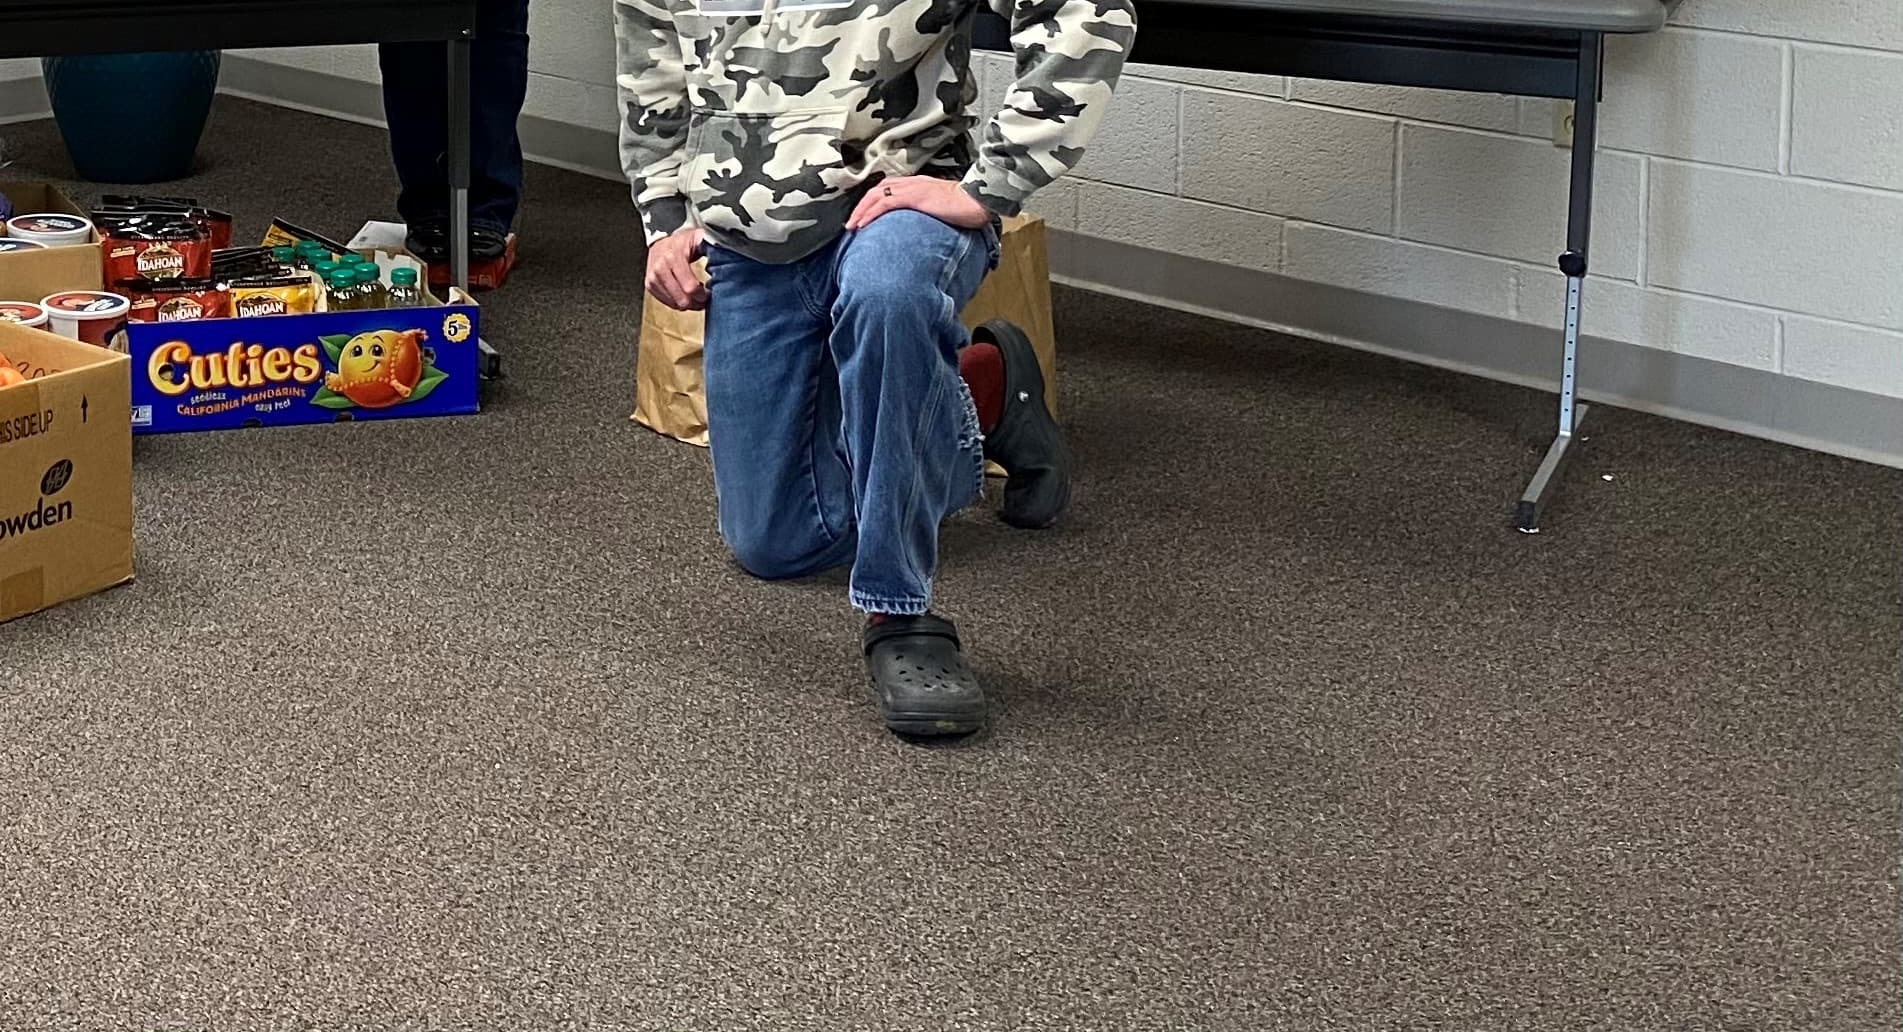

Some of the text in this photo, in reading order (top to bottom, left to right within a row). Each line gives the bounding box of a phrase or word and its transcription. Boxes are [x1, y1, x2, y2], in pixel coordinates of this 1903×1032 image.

[138, 256, 183, 272] IDAHOAN
[159, 307, 202, 322] IDAHOAN
[240, 302, 284, 318] IDAHOAN
[448, 321, 458, 336] 5
[148, 341, 322, 396] Cuties
[177, 387, 307, 416] CALIFORNIA MANDARINS
[14, 413, 38, 439] SIDE
[39, 409, 53, 434] UP
